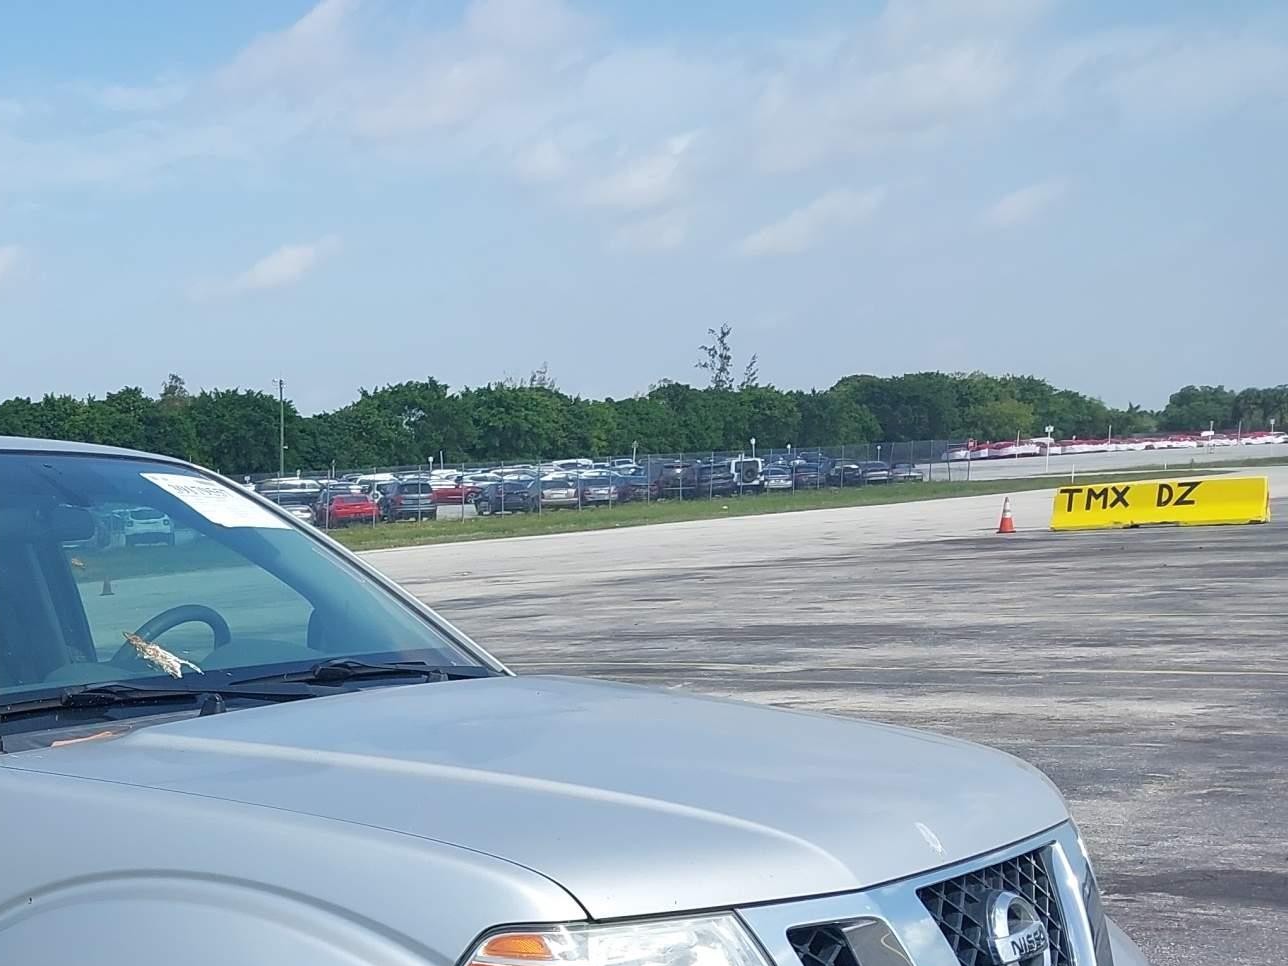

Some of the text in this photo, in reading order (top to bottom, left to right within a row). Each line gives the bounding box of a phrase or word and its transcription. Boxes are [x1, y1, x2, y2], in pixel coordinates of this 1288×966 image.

[1059, 481, 1203, 512] TMX DZ
[1010, 928, 1046, 956] NISSA
